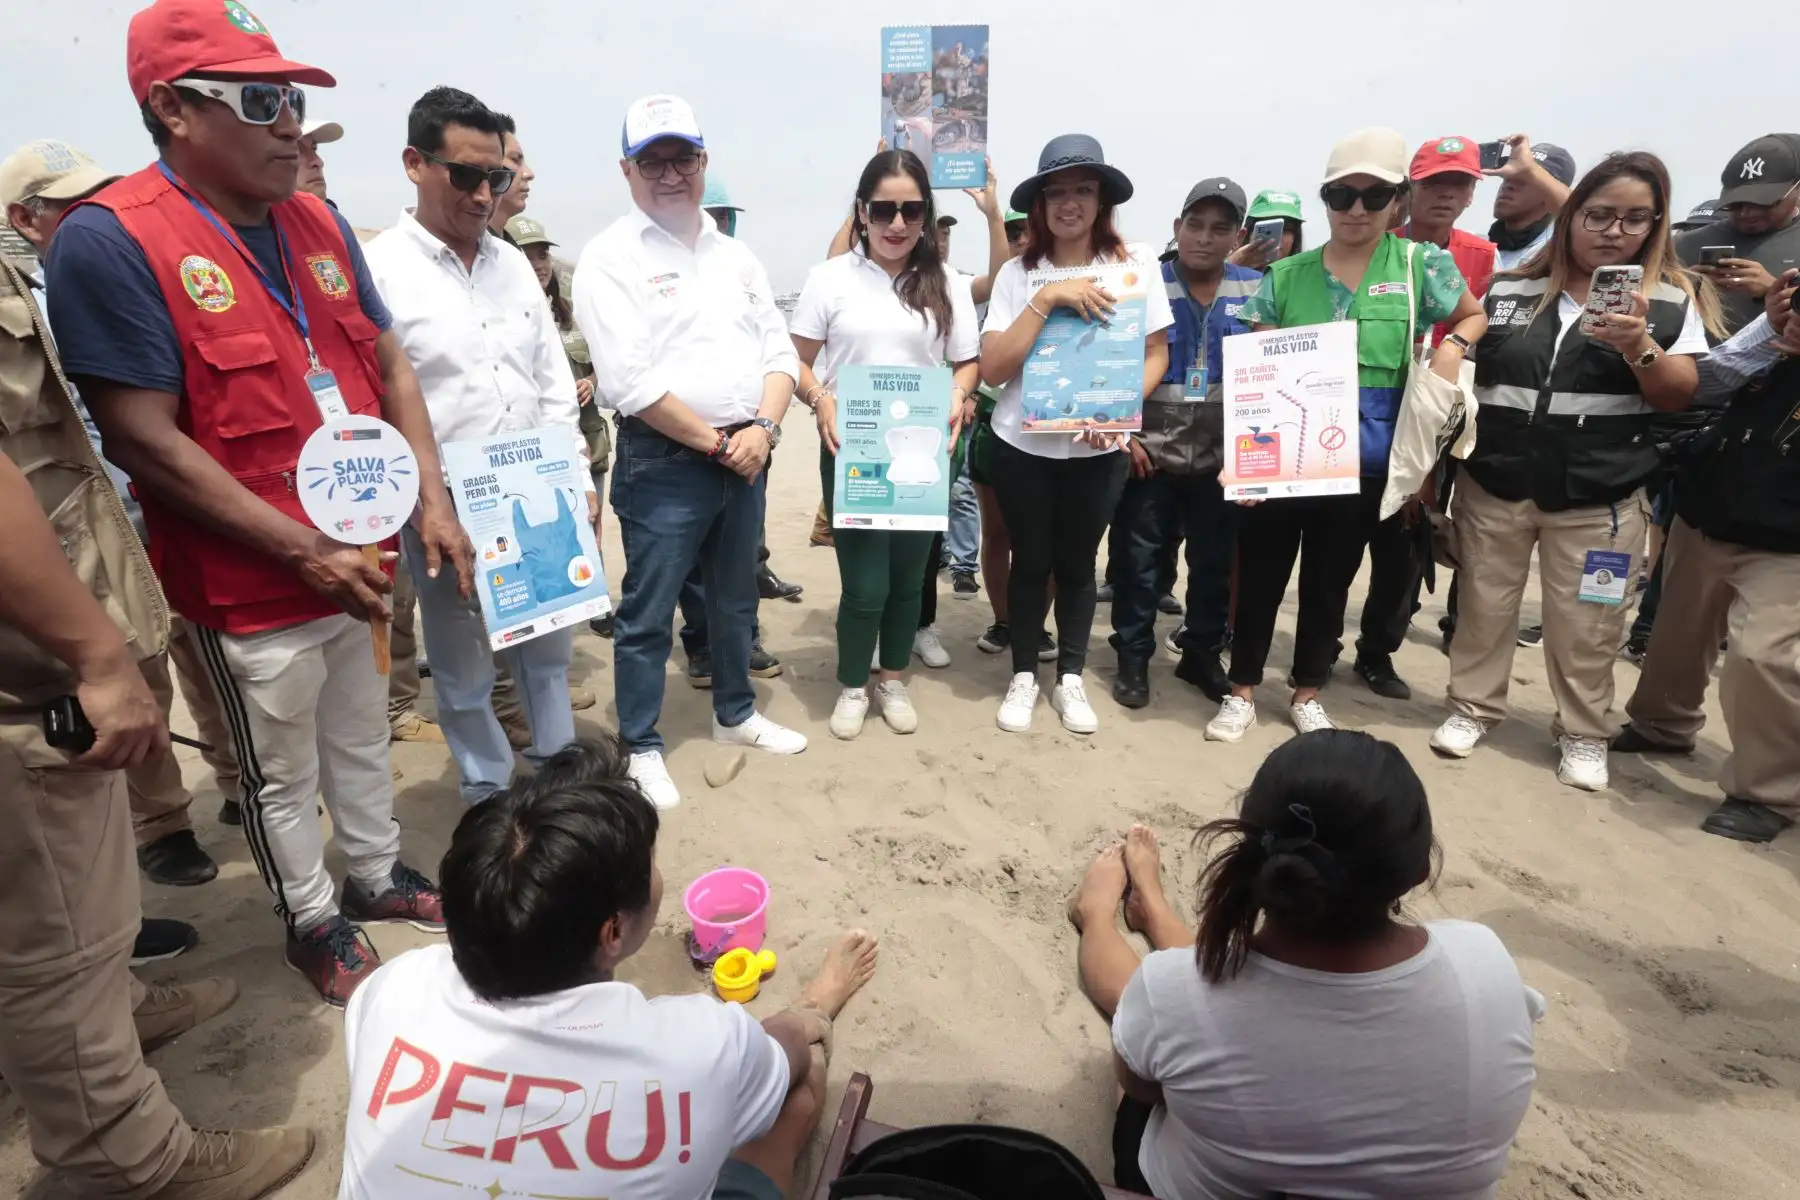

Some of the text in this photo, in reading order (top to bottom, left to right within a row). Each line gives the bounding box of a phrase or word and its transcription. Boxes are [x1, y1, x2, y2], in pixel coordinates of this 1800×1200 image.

[1496, 300, 1516, 308] CHO
[1494, 308, 1513, 316] RRI
[1265, 332, 1319, 346] MENOS PLÁSTICO
[1263, 340, 1318, 357] MÁS VIDA
[896, 372, 922, 380] PLÁSTICO
[1234, 368, 1247, 376] SIN
[1234, 374, 1275, 384] POR FAVOR
[873, 380, 920, 392] MÁS VIDA
[846, 399, 882, 408] LIBRES DE
[847, 408, 881, 416] TECNOPOR
[1234, 407, 1271, 418] 200 años
[489, 438, 540, 453] MENOS PLÁSTICO
[489, 446, 544, 468] MÁS VIDA
[333, 456, 386, 476] SALVA
[338, 472, 384, 488] PLAYAS
[462, 474, 498, 488] GRACIAS
[465, 484, 500, 500] PERO NO
[499, 593, 529, 606] 400 años
[366, 1035, 692, 1172] PERU!
